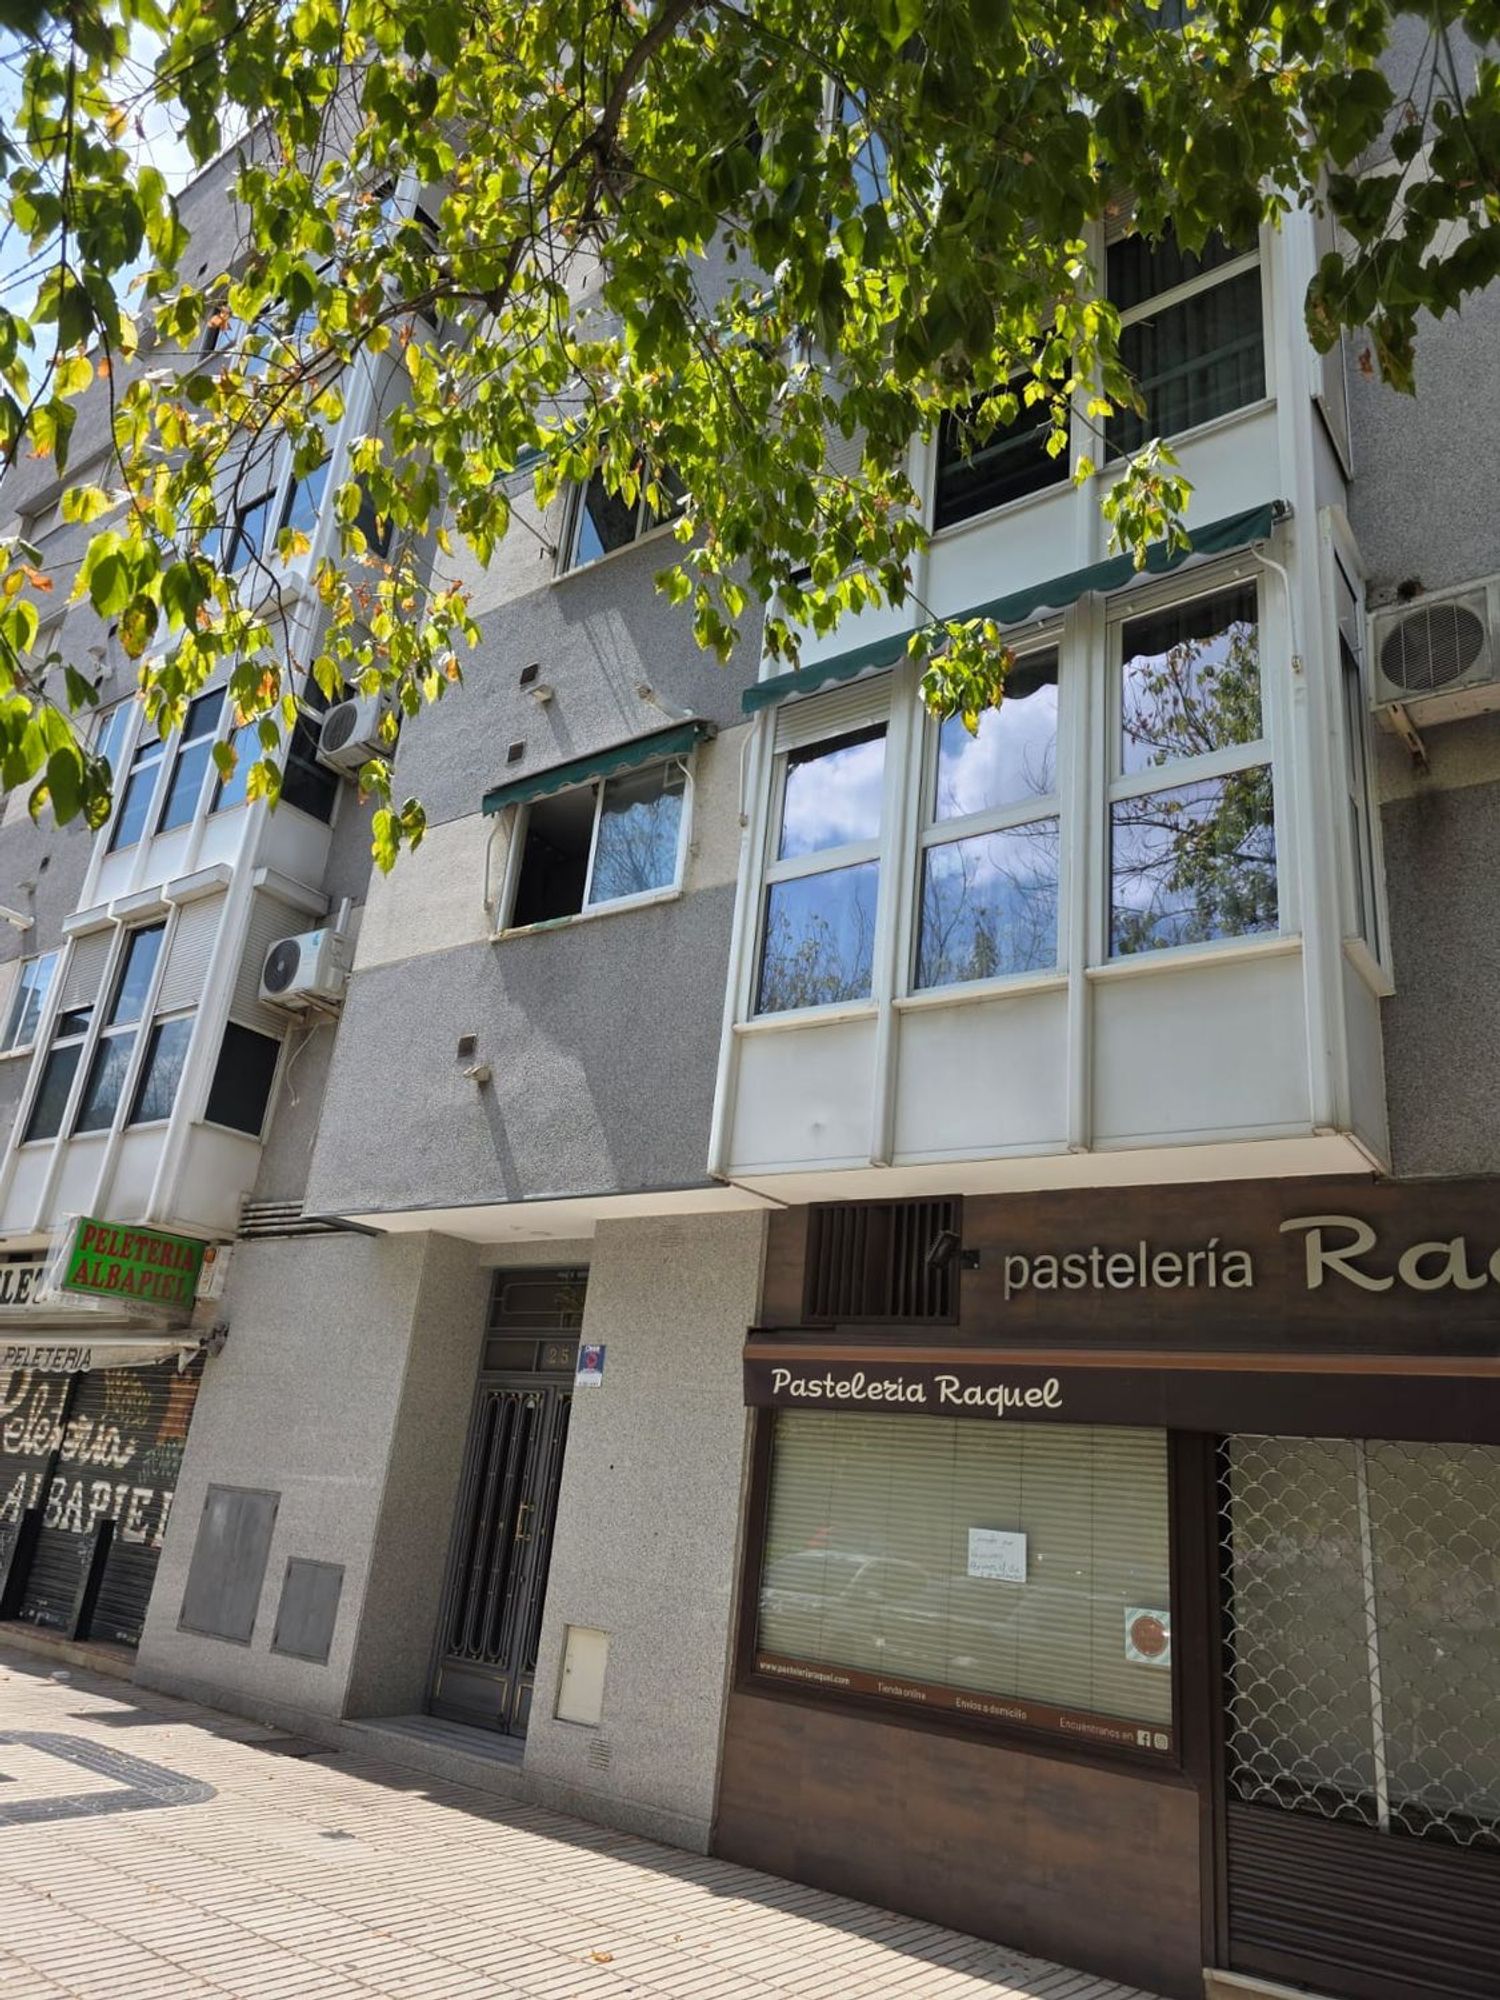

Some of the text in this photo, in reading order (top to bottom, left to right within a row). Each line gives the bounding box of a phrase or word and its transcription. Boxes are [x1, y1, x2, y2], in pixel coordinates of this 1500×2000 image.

[79, 1223, 195, 1272] PELETERIA
[1003, 1214, 1500, 1300] pastelería Ra
[72, 1258, 186, 1302] ALBAPIEL
[3, 1346, 92, 1372] PELETERIA
[549, 1347, 569, 1365] 25
[771, 1368, 1063, 1417] Pasteleria Raquel
